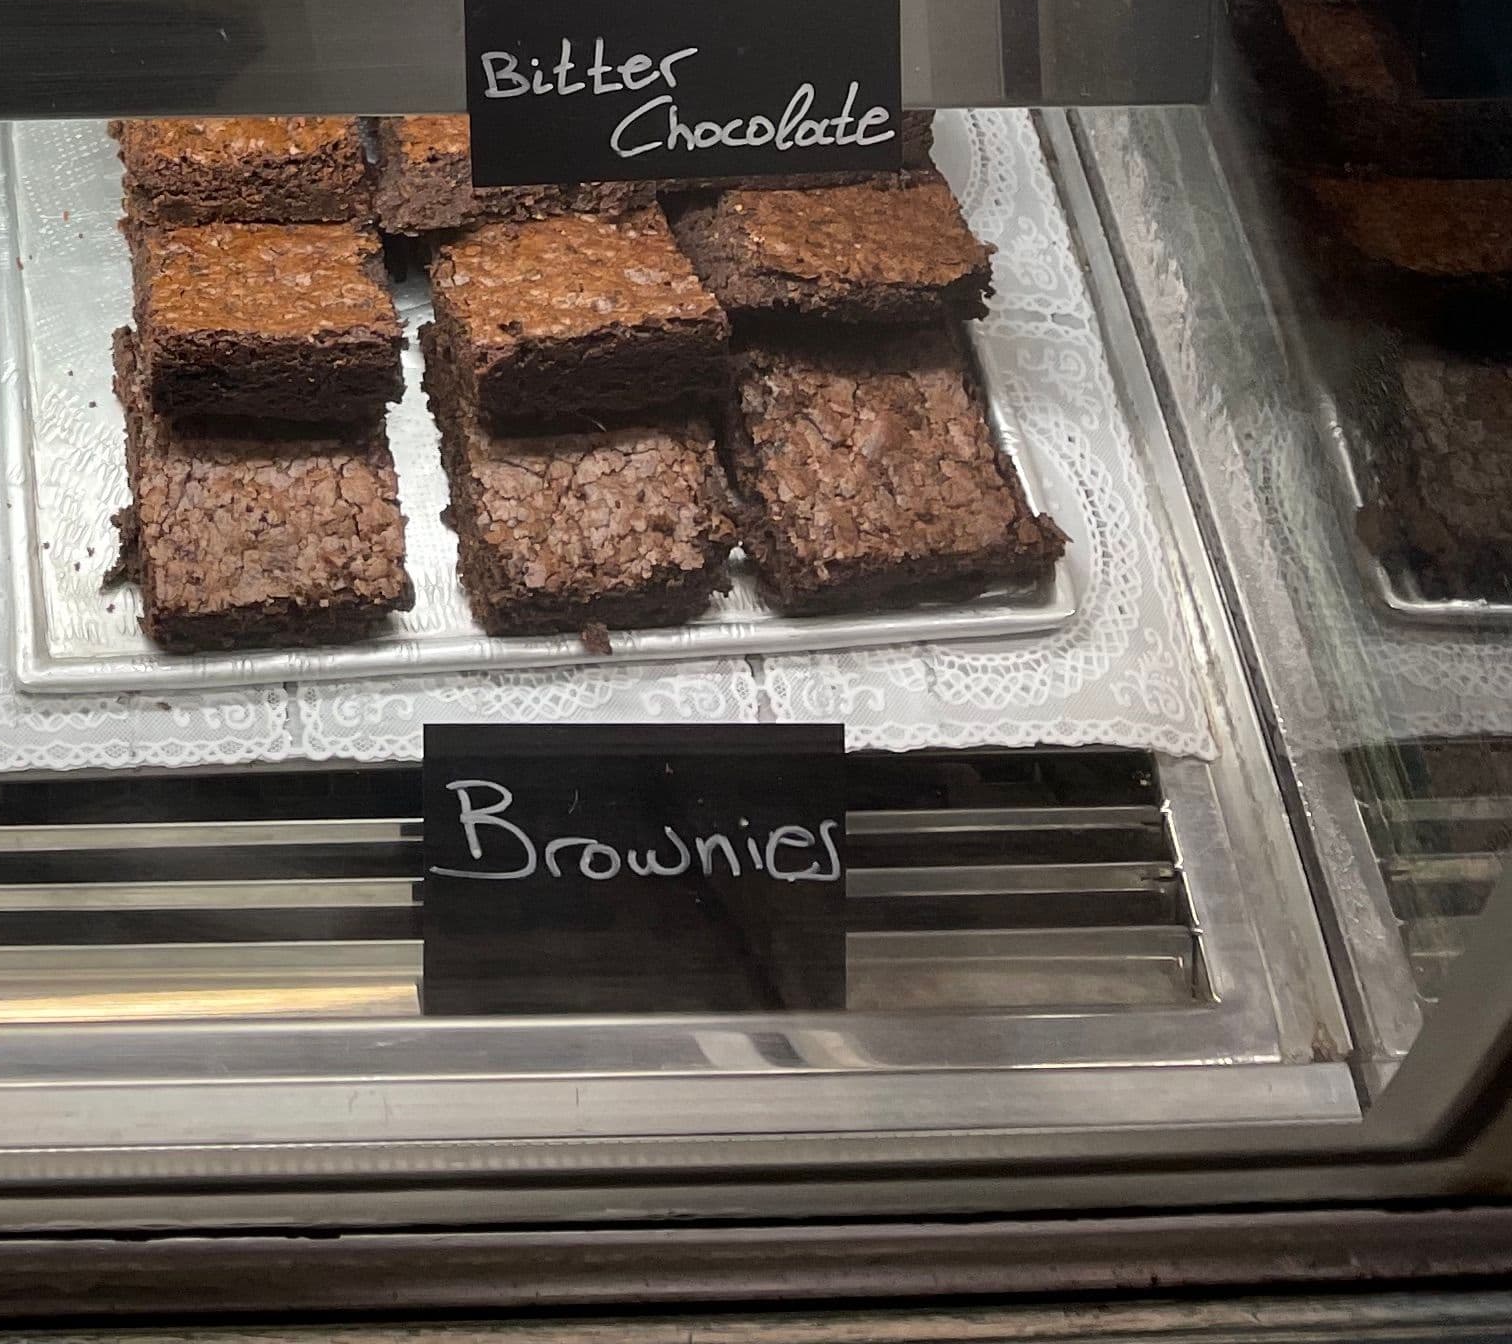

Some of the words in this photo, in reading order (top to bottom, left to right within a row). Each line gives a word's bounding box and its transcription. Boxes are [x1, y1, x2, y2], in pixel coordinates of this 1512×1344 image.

[482, 36, 698, 97] Bitter
[609, 81, 895, 158] Chocolate
[429, 780, 842, 882] Brownies
